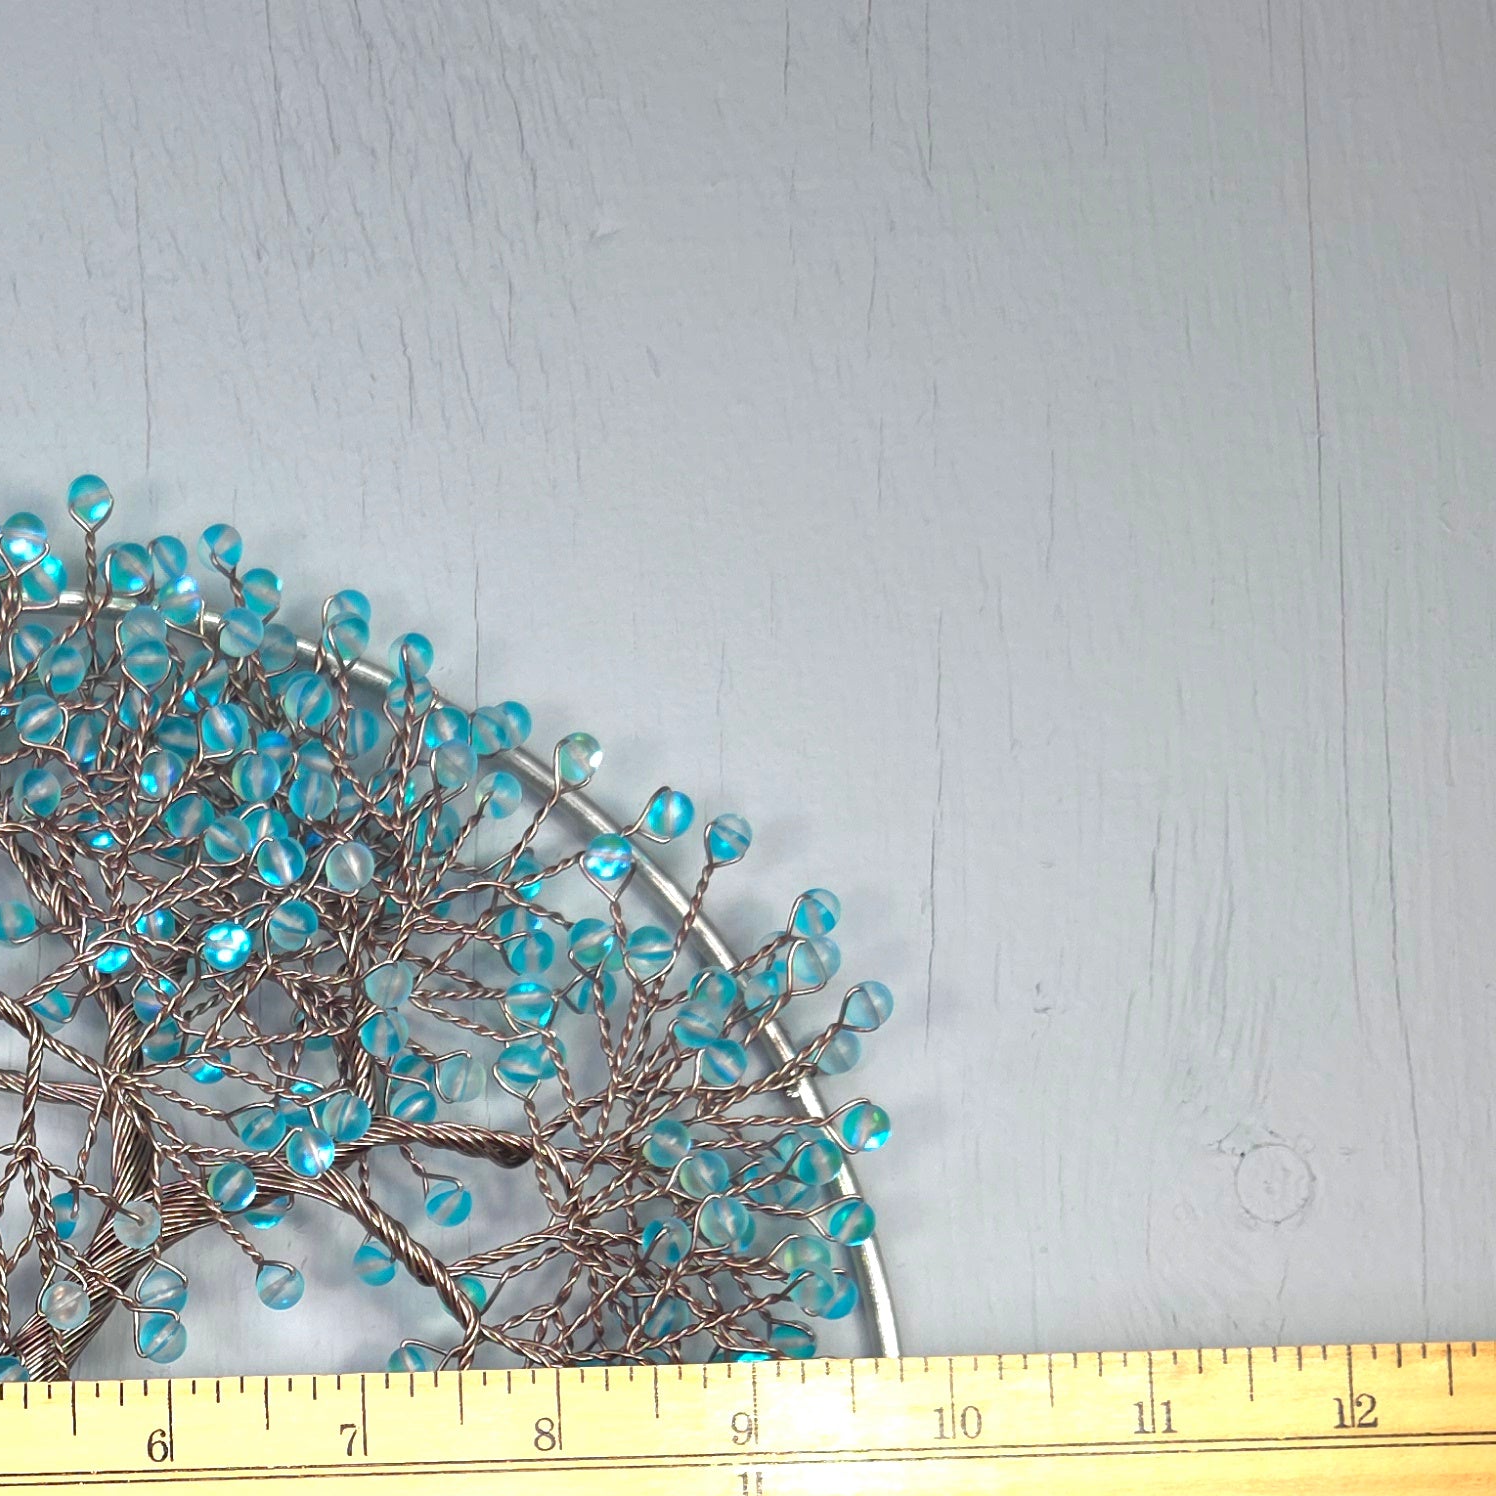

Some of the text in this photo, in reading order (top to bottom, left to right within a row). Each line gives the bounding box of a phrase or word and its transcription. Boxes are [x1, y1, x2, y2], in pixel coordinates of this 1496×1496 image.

[931, 1405, 983, 1440] 10
[1133, 1400, 1179, 1435] 11
[1332, 1392, 1379, 1429] 12
[147, 1429, 169, 1463] 6
[339, 1422, 358, 1457] 7
[533, 1417, 556, 1452] 8
[730, 1411, 754, 1446] 9
